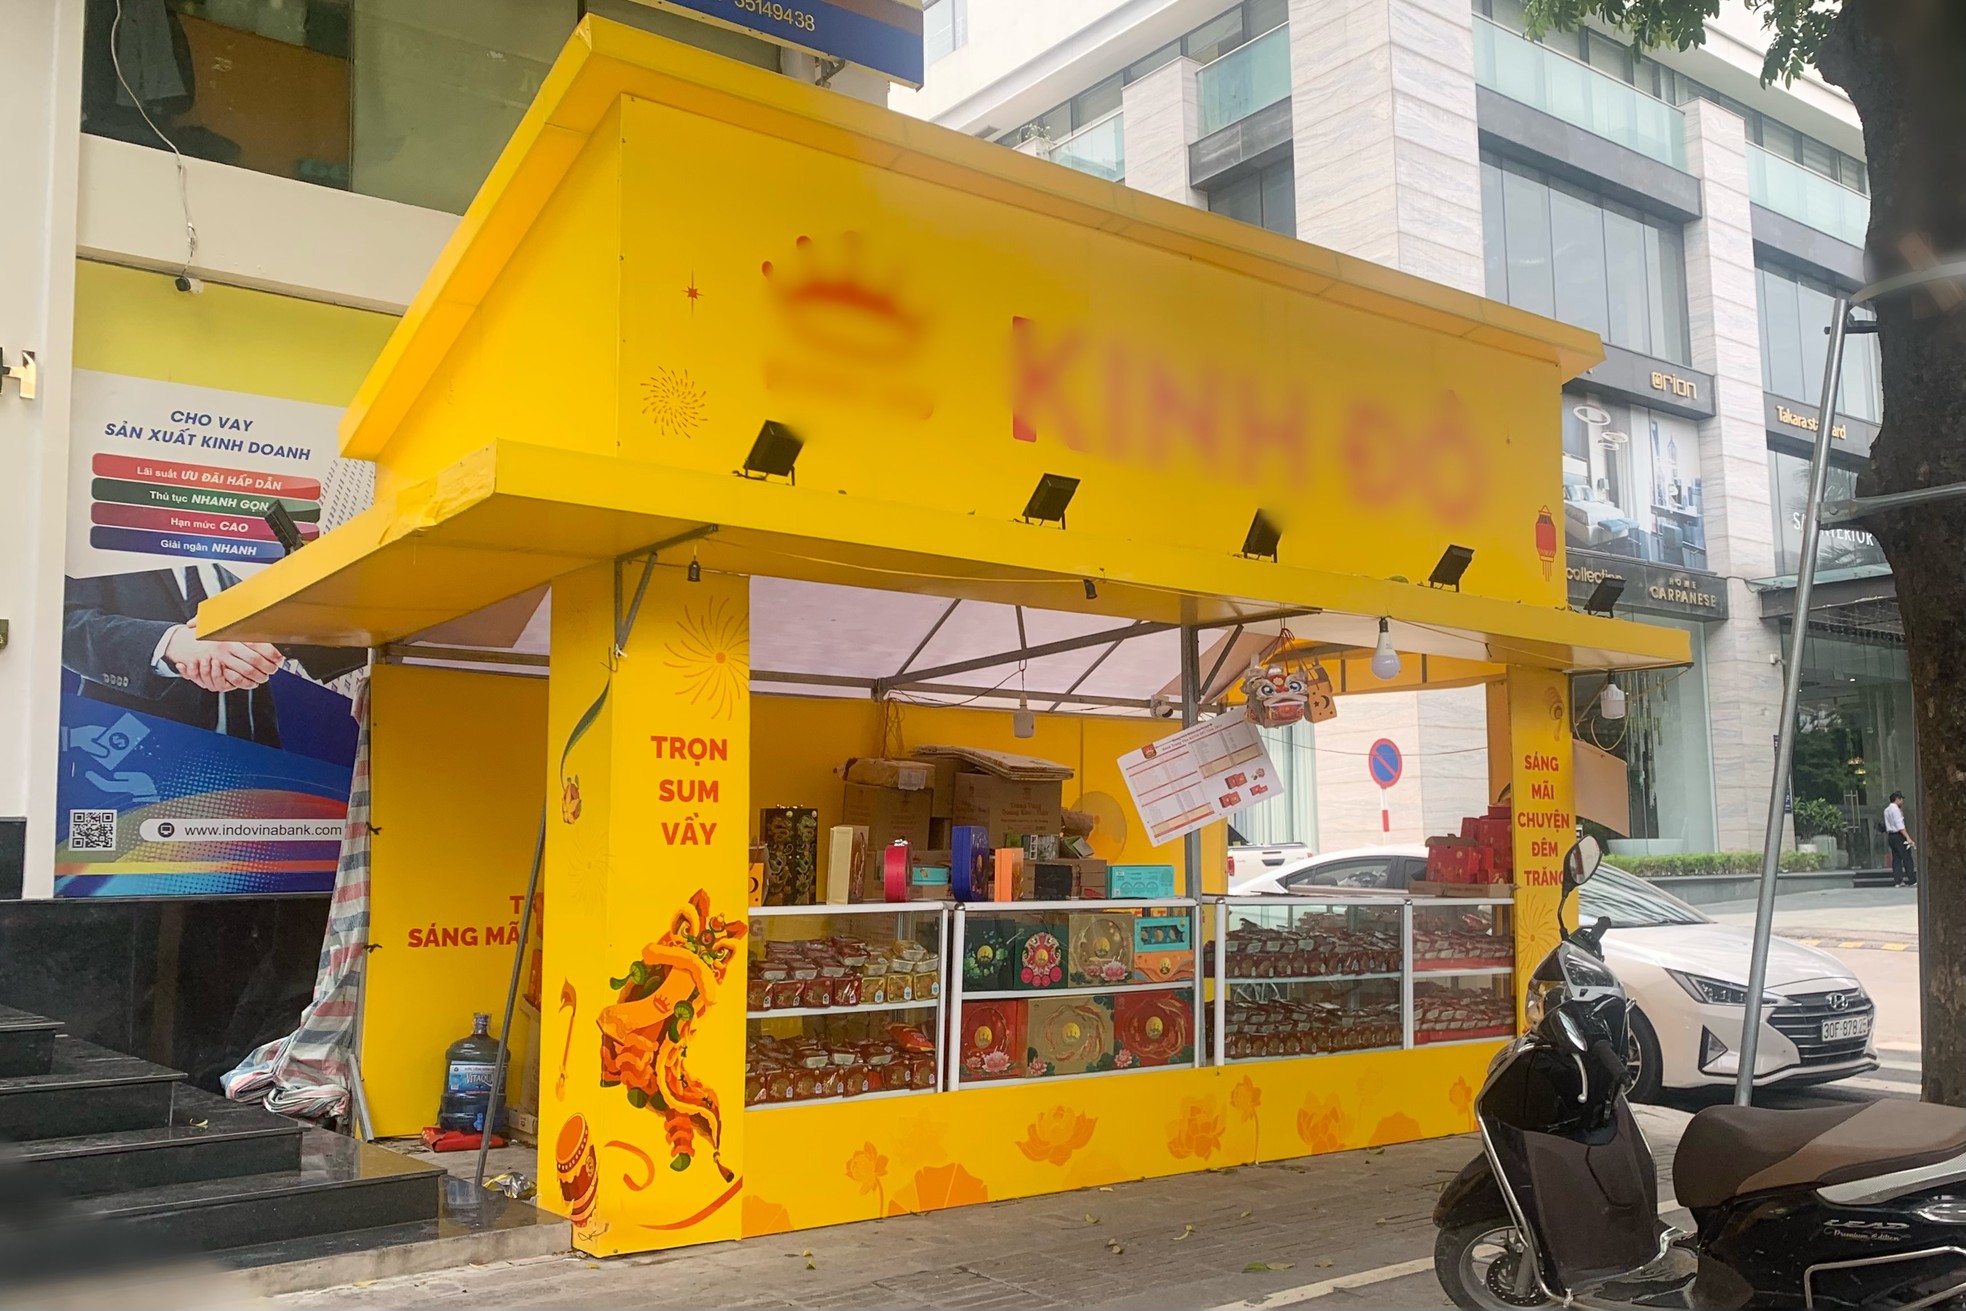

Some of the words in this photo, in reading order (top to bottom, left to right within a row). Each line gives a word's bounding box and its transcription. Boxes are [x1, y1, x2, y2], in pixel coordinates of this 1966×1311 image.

[170, 410, 212, 427] CHO
[218, 416, 253, 432] VAY
[1776, 405, 1807, 429] Takara
[1807, 416, 1847, 440] stard
[104, 420, 143, 439] SẢN
[147, 427, 197, 446] XUẤT
[200, 436, 244, 452] KINH
[247, 442, 311, 461] DOANH
[136, 465, 153, 477] Lãi
[180, 469, 199, 481] ƯU
[201, 472, 225, 485] ĐÃI
[226, 472, 253, 488] HẤP
[254, 475, 282, 491] DẪN
[149, 489, 170, 502] Thủ
[171, 493, 188, 505] tục
[191, 494, 237, 508] NHANH
[239, 499, 269, 512] GỌN
[170, 517, 191, 529] Hạn
[193, 518, 217, 530] mức
[219, 521, 249, 533] CAO
[160, 539, 182, 549] Giải
[183, 541, 209, 553] ngân
[211, 543, 257, 557] NHANH
[1668, 577, 1697, 589] HOME
[1649, 586, 1716, 608] CARPANESE
[650, 735, 728, 767] TRỌN
[1524, 752, 1559, 772] SÁNG
[658, 779, 719, 803] SUM
[1531, 780, 1554, 800] MÃI
[184, 821, 342, 837] www.indovinabank.com
[661, 812, 717, 846] VẦY
[1517, 809, 1570, 833] CHUYỆN
[1531, 838, 1559, 858] ĐÊM
[407, 922, 478, 948] SÁNG
[485, 920, 529, 946] MÃ
[465, 1072, 495, 1087] VITAQU
